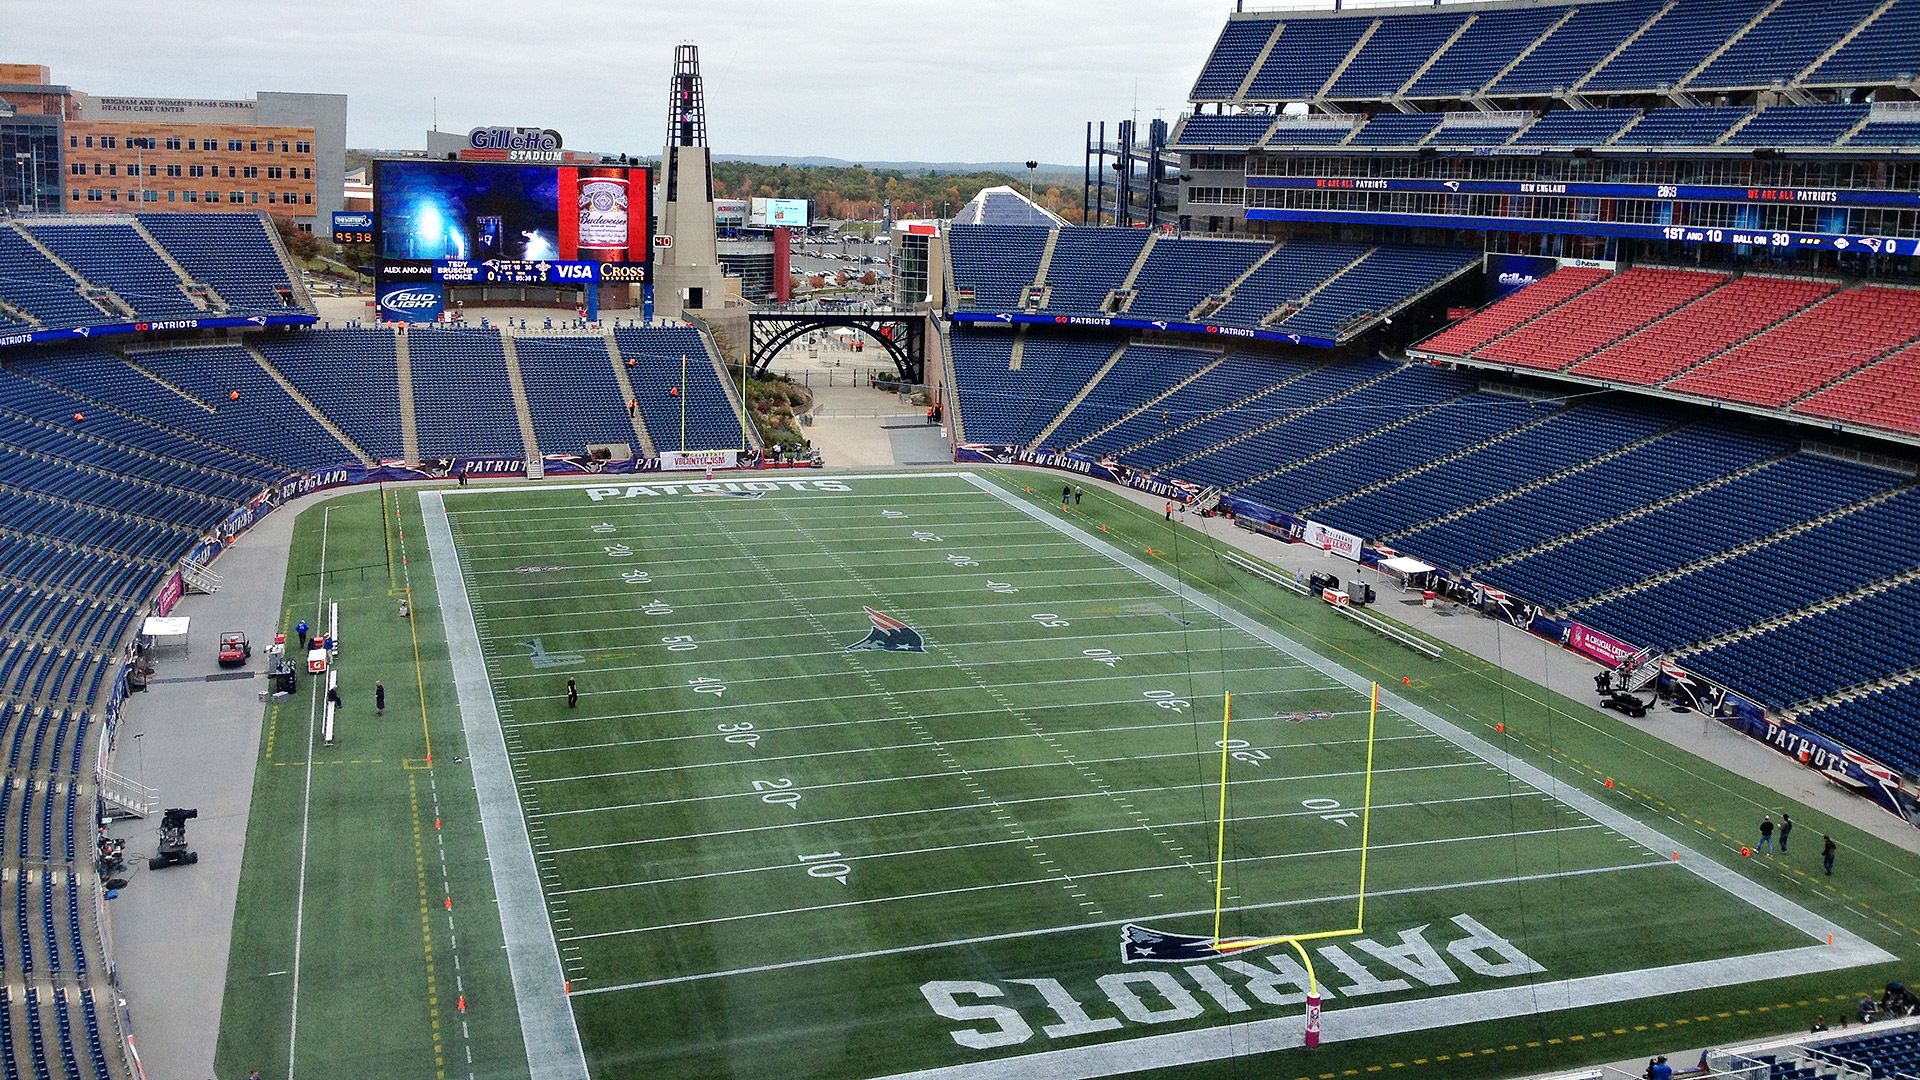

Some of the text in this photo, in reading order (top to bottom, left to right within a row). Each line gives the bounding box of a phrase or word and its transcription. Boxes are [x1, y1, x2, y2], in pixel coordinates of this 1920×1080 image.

[471, 129, 554, 150] Gillette
[510, 150, 562, 161] STADIUM
[1355, 180, 1388, 189] PATRIOTS
[1521, 184, 1566, 193] NEW ENGLAND
[1747, 189, 1837, 201] WE ARE ALL PATRIOTS
[580, 212, 627, 226] Budweiser
[655, 238, 670, 246] 40
[1663, 227, 1790, 246] 1ST AND 10 BALL ON 30
[1885, 239, 1896, 253] 0
[487, 271, 495, 281] 0
[539, 271, 547, 281] 3
[555, 264, 593, 279] VISA
[396, 293, 434, 301] BUD
[389, 301, 437, 309] LIGHT
[135, 319, 198, 331] GO PATRIOTS
[1070, 316, 1111, 325] PATRIOTS
[1206, 325, 1254, 337] GO PATRIOTS
[674, 456, 726, 466] VOLUNTEEISM
[1019, 450, 1091, 474] NEW ENGLAND
[298, 470, 347, 493] ENGLAND
[1134, 476, 1179, 498] PATRIOTS
[585, 480, 852, 501] PATRIOTS
[912, 531, 943, 543] 20
[604, 544, 633, 557] 20
[947, 555, 979, 567] 30
[622, 571, 652, 583] 30
[986, 582, 1019, 594] 40
[641, 602, 673, 615] 40
[1031, 613, 1070, 628] 50
[661, 635, 698, 651] 50
[1584, 633, 1590, 641] A
[1590, 635, 1613, 652] CRUCIAL
[1082, 648, 1123, 663] 40
[313, 661, 321, 669] G
[688, 677, 727, 693] 40
[1143, 690, 1190, 709] 30
[717, 721, 761, 743] 30
[1215, 739, 1272, 761] 20
[1765, 723, 1849, 775] PATRIOTS
[752, 778, 801, 804] 20
[1301, 798, 1360, 821] 10
[797, 850, 851, 878] 10
[920, 913, 1548, 1050] PATRIOTS
